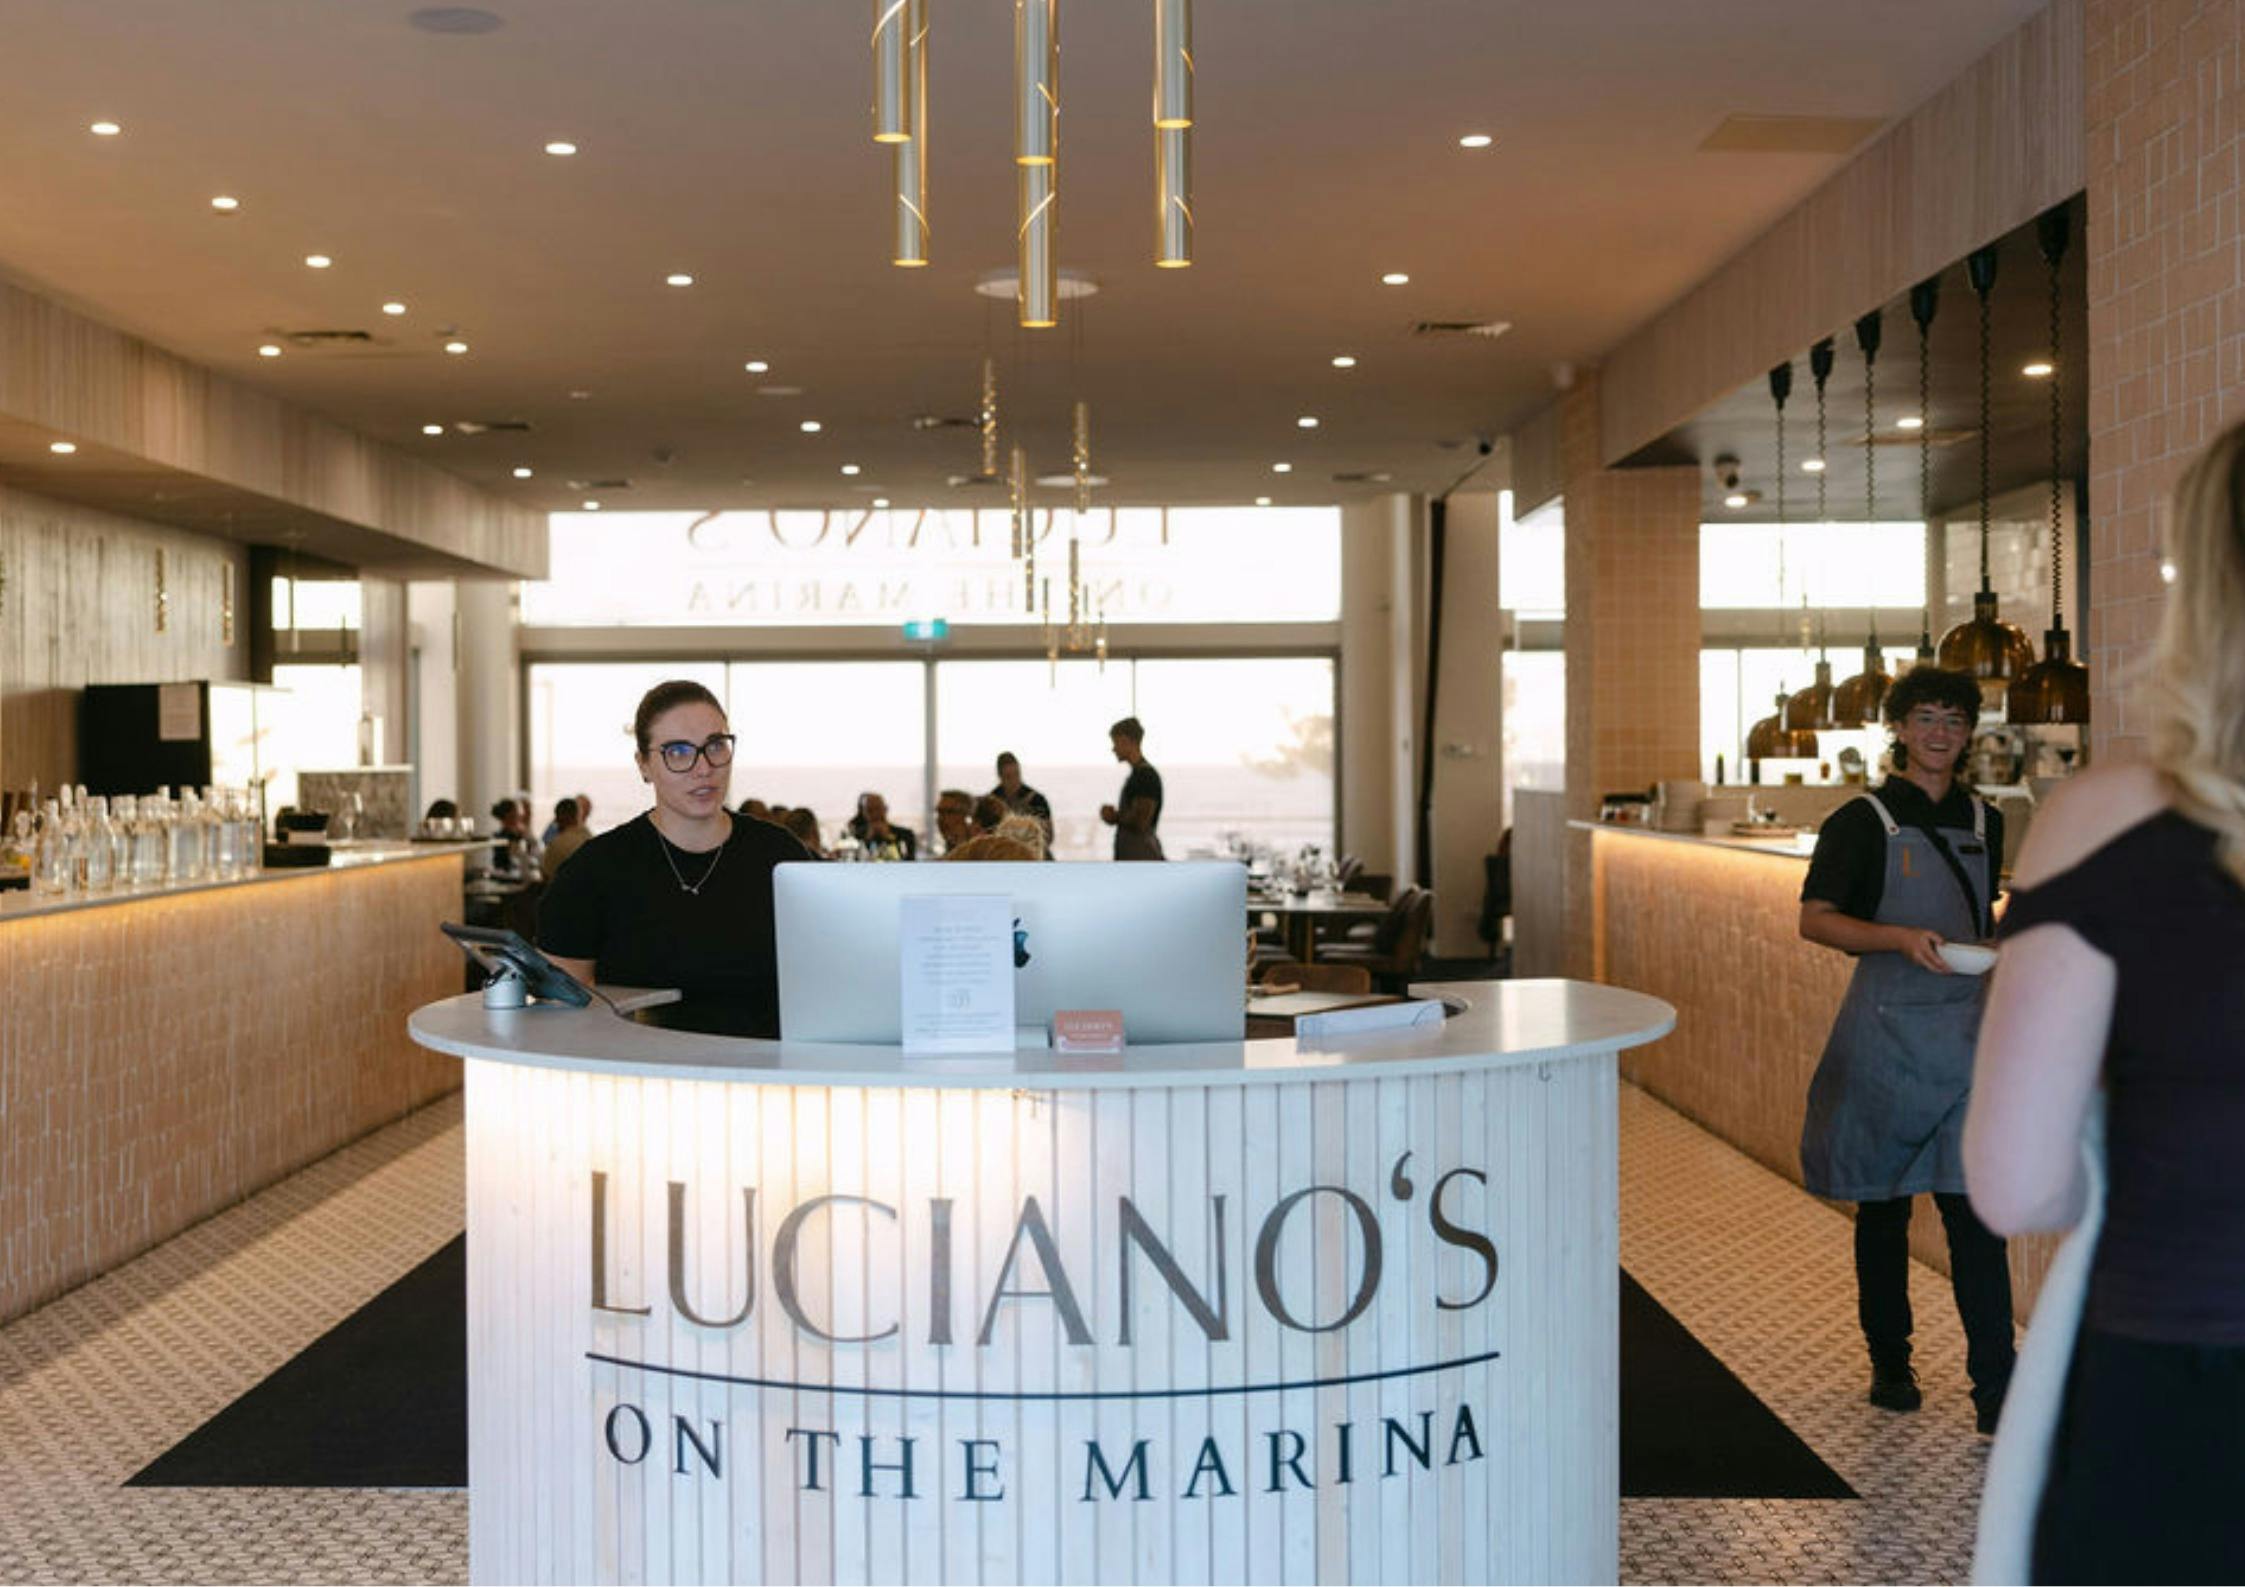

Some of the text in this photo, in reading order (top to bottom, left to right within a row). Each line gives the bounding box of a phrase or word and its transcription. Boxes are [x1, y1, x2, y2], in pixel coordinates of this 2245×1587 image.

[590, 1150, 1500, 1347] LUCIANO'S
[603, 1402, 1486, 1503] ON THE MARINA
